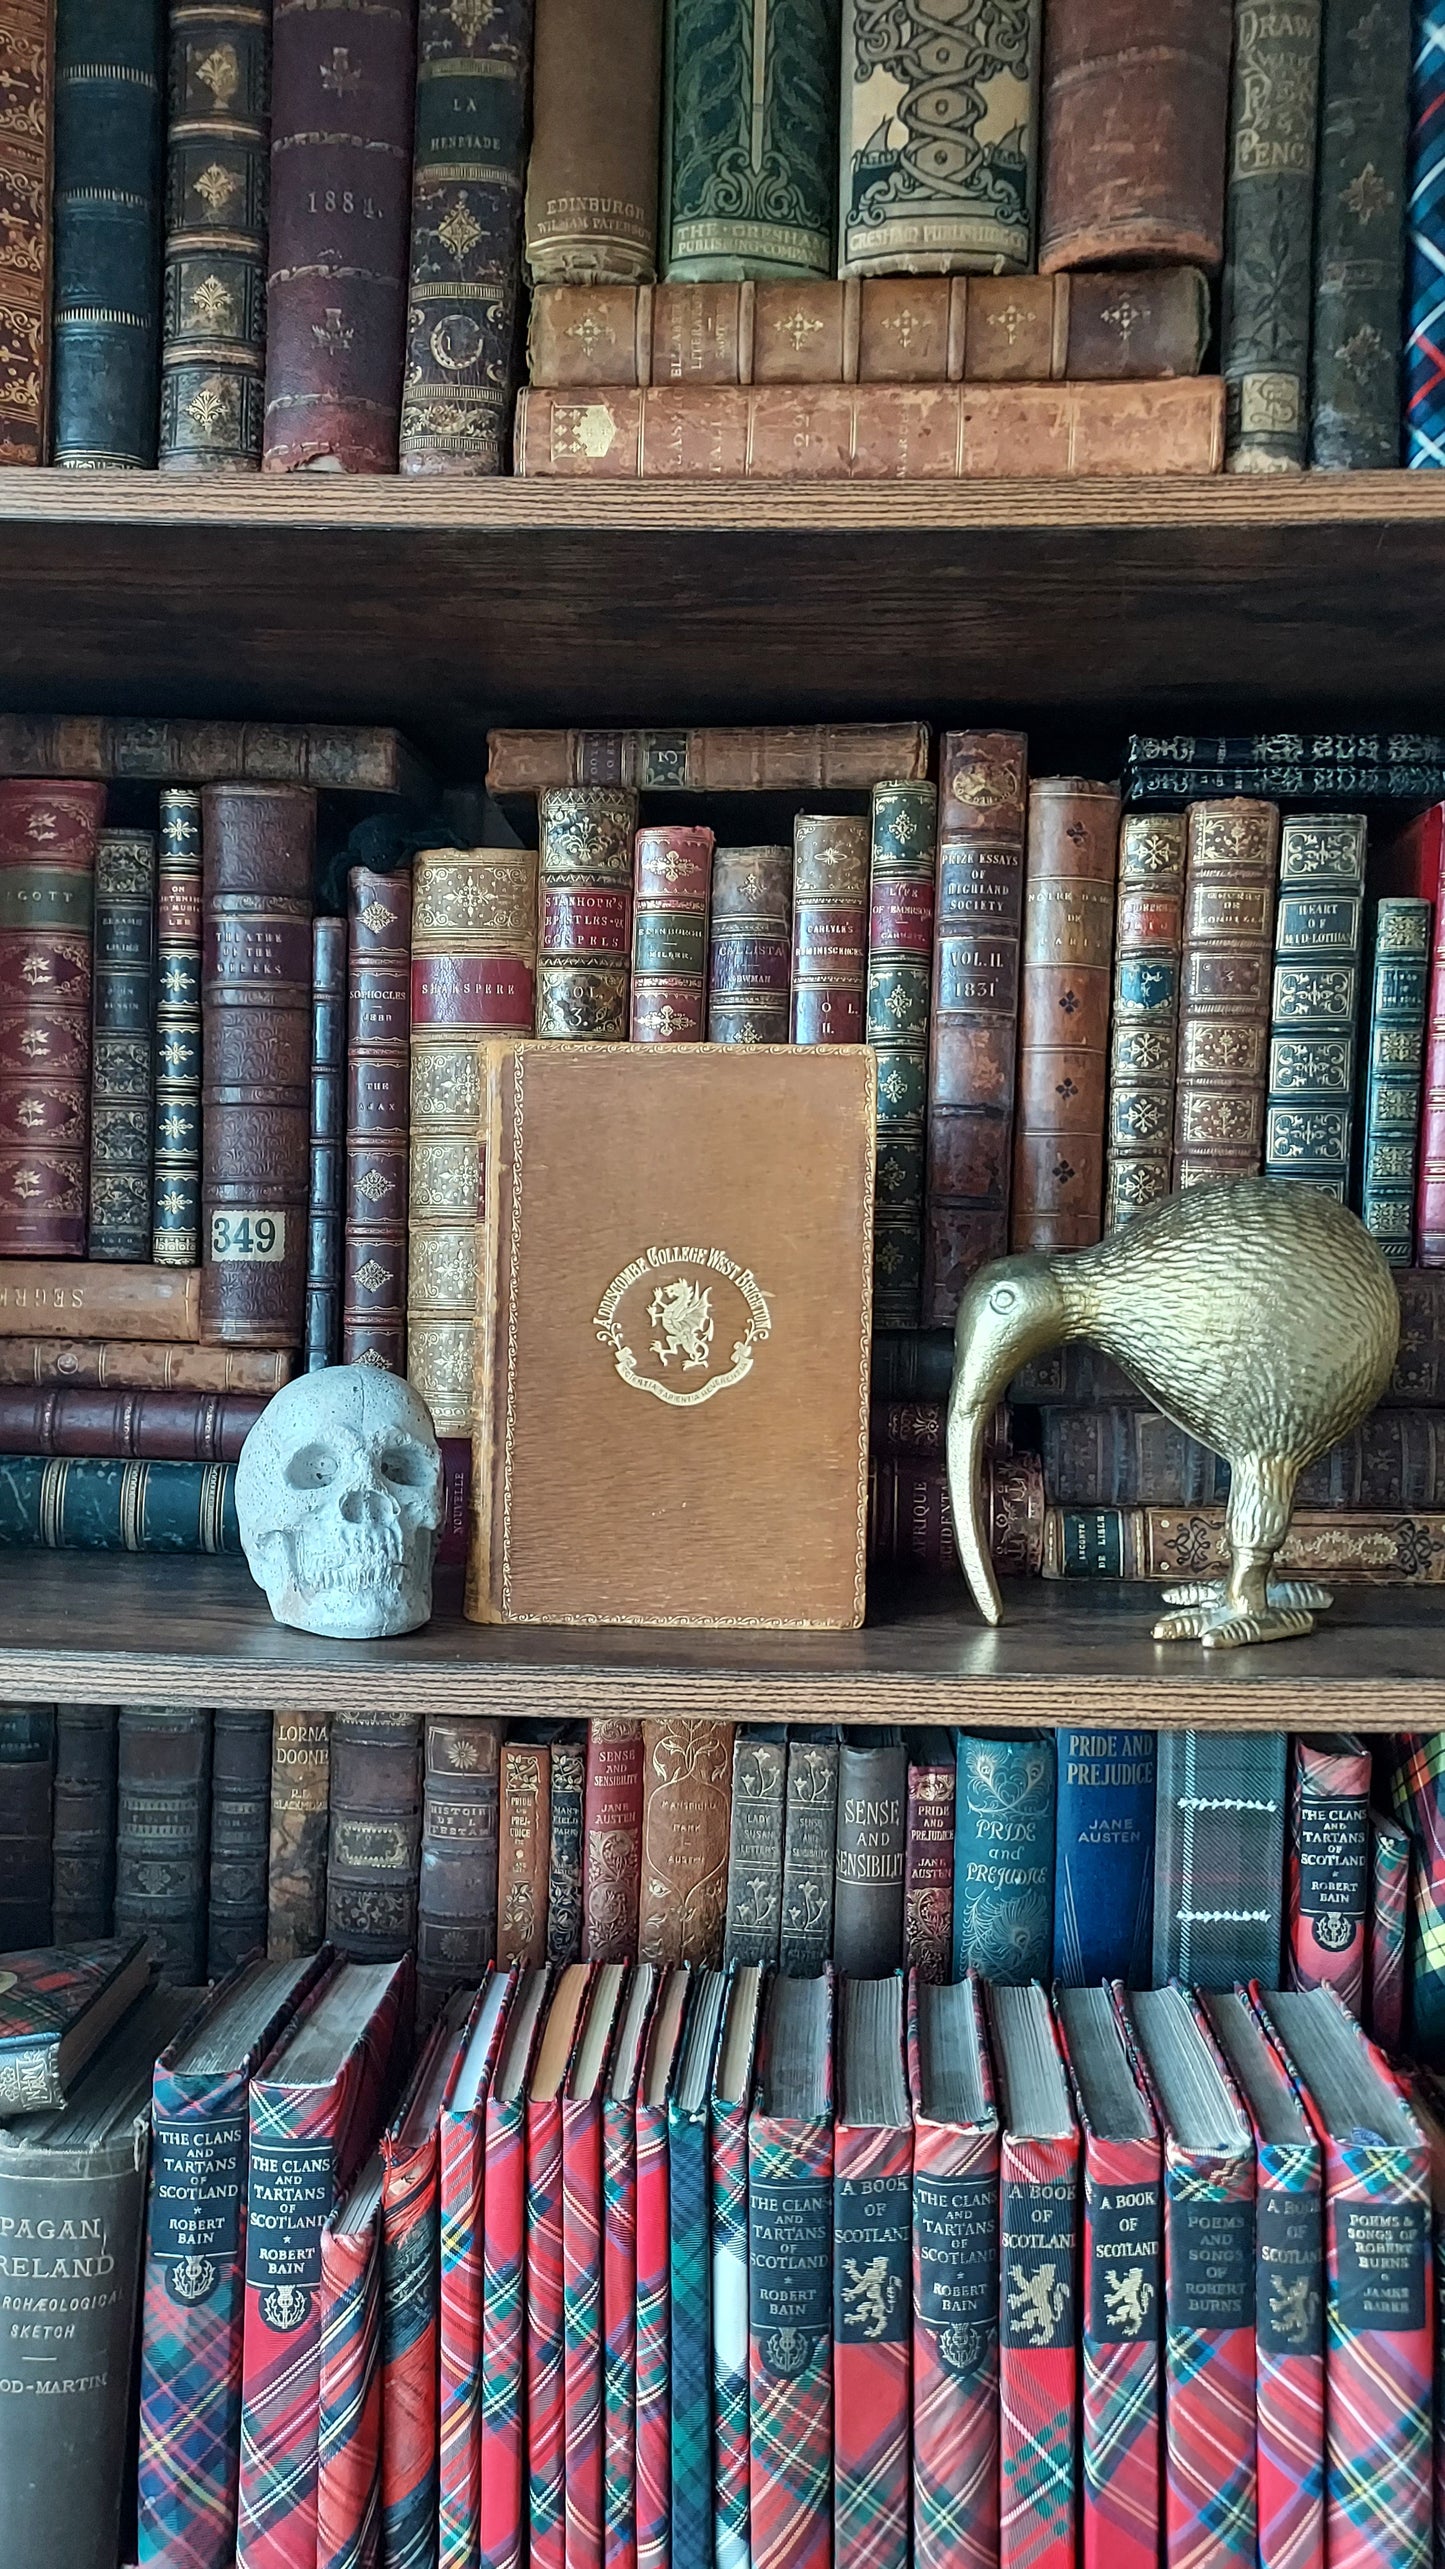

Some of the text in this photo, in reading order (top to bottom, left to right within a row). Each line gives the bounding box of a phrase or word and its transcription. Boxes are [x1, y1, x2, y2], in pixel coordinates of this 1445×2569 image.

[453, 99, 477, 112] LA
[546, 197, 645, 221] EDINBURGH
[677, 222, 717, 239] THE
[658, 749, 678, 765] 3
[942, 853, 1018, 866] PRIZE ESSAYS
[971, 870, 985, 880] OF
[889, 886, 919, 897] LIFE
[948, 885, 1010, 896] HIGHLAND
[545, 897, 624, 910] STANHOPE'S
[1028, 892, 1073, 903] NOTRE
[872, 905, 931, 917] OF EMERSON
[950, 901, 1004, 912] SOCIETY
[1299, 904, 1338, 916] HEART
[807, 922, 854, 934] CARLYLE'S
[1308, 918, 1327, 929] OF
[215, 932, 283, 943] THEATRE
[544, 935, 619, 947] GOSPELS
[223, 947, 272, 958] OF THE
[719, 946, 784, 957] CALLISTA
[216, 964, 282, 974] GREEKS
[350, 990, 406, 1000] SOPHOCLES
[422, 983, 515, 995] SHAKSPERE
[955, 982, 996, 997] 1831
[363, 1013, 392, 1022] JEBB
[213, 1216, 277, 1254] 349
[593, 1246, 772, 1330] ADDISCOMBE COLLEGE WEST BRIGHTON
[453, 1472, 464, 1534] NOUVELLE
[912, 1481, 928, 1557] AFRIQUE
[1097, 1515, 1106, 1569] DE LISLE
[278, 1725, 329, 1742] LORNA
[1069, 1734, 1153, 1758] PRIDE AND
[277, 1748, 329, 1765] DOONE
[599, 1749, 636, 1762] SENSE
[606, 1764, 627, 1774] AND
[1067, 1762, 1153, 1786] PREJUDICE
[594, 1774, 639, 1787] SENSIBILITY
[601, 1802, 629, 1813] JANE
[844, 1799, 900, 1827] SENSE
[917, 1806, 950, 1817] PRIDE
[594, 1812, 636, 1824] AUSTEN
[747, 1814, 771, 1824] LADY
[1302, 1809, 1367, 1821] THE CLANS
[673, 1824, 701, 1833] PARK
[923, 1819, 944, 1828] AND
[975, 1818, 1037, 1842] PRIDE
[1088, 1818, 1134, 1830] JANE
[1323, 1822, 1347, 1830] AND
[744, 1829, 775, 1839] SUSAN
[856, 1832, 890, 1846] AND
[911, 1830, 954, 1841] PREJUDICE
[1078, 1831, 1141, 1844] AUSTEN
[1302, 1832, 1365, 1844] TARTANS
[988, 1845, 1024, 1861] and
[1327, 1845, 1342, 1853] OF
[836, 1851, 904, 1878] SENSIBILIT
[918, 1858, 947, 1867] JANE
[1301, 1853, 1366, 1866] SCOTLAND
[911, 1868, 952, 1879] AUSTEN
[966, 1862, 1048, 1891] PREJUDICE
[1311, 1881, 1358, 1892] ROBERT
[1319, 1893, 1350, 1903] BAIN
[159, 2130, 242, 2147] THE CLANS
[186, 2148, 214, 2158] AND
[163, 2158, 237, 2173] TARTANS
[251, 2156, 331, 2173] THE CLANS
[190, 2176, 207, 2185] OF
[274, 2175, 302, 2185] AND
[840, 2176, 910, 2196] A BOOK
[159, 2185, 238, 2199] SCOTLAND
[253, 2187, 325, 2201] TARTANS
[917, 2189, 997, 2208] THE CLANS
[1008, 2184, 1076, 2200] A BOOK
[750, 2198, 779, 2212] THE
[1099, 2191, 1157, 2210] A BOOK
[1267, 2198, 1280, 2214] A
[279, 2204, 296, 2213] OF
[864, 2202, 888, 2217] OF
[945, 2210, 973, 2220] AND
[250, 2213, 330, 2228] SCOTLAND
[774, 2215, 803, 2224] AND
[1031, 2210, 1053, 2223] OF
[1187, 2216, 1245, 2228] POEMS
[1349, 2214, 1400, 2227] POEMS
[0, 2217, 101, 2240] PAGAN
[169, 2217, 225, 2230] ROBERT
[922, 2219, 996, 2235] TARTANS
[1118, 2218, 1139, 2232] OF
[177, 2232, 215, 2245] BAIN
[753, 2225, 827, 2241] TARTANS
[1286, 2225, 1309, 2239] OF
[1347, 2227, 1418, 2241] SONGS OF
[951, 2238, 968, 2248] OF
[1200, 2234, 1233, 2246] AND
[259, 2247, 315, 2260] ROBERT
[780, 2243, 798, 2253] OF
[1354, 2242, 1413, 2254] ROBERT
[749, 2253, 829, 2269] SCOTLAND
[921, 2246, 996, 2265] SCOTLAND
[1188, 2249, 1243, 2262] SONGS
[0, 2255, 116, 2278] RELAND
[268, 2262, 305, 2275] BAIN
[1358, 2256, 1410, 2269] BURNS
[1206, 2266, 1228, 2279] OF
[760, 2288, 817, 2302] ROBERT
[933, 2282, 988, 2296] ROBERT
[1185, 2282, 1247, 2295] ROBERT
[1363, 2287, 1410, 2299] JAMES
[769, 2303, 806, 2315] BAIN
[941, 2300, 978, 2312] BAIN
[1188, 2299, 1242, 2312] BURNS
[10, 2324, 76, 2339] SKETCH
[0, 2371, 107, 2394] OD-MARTIN
